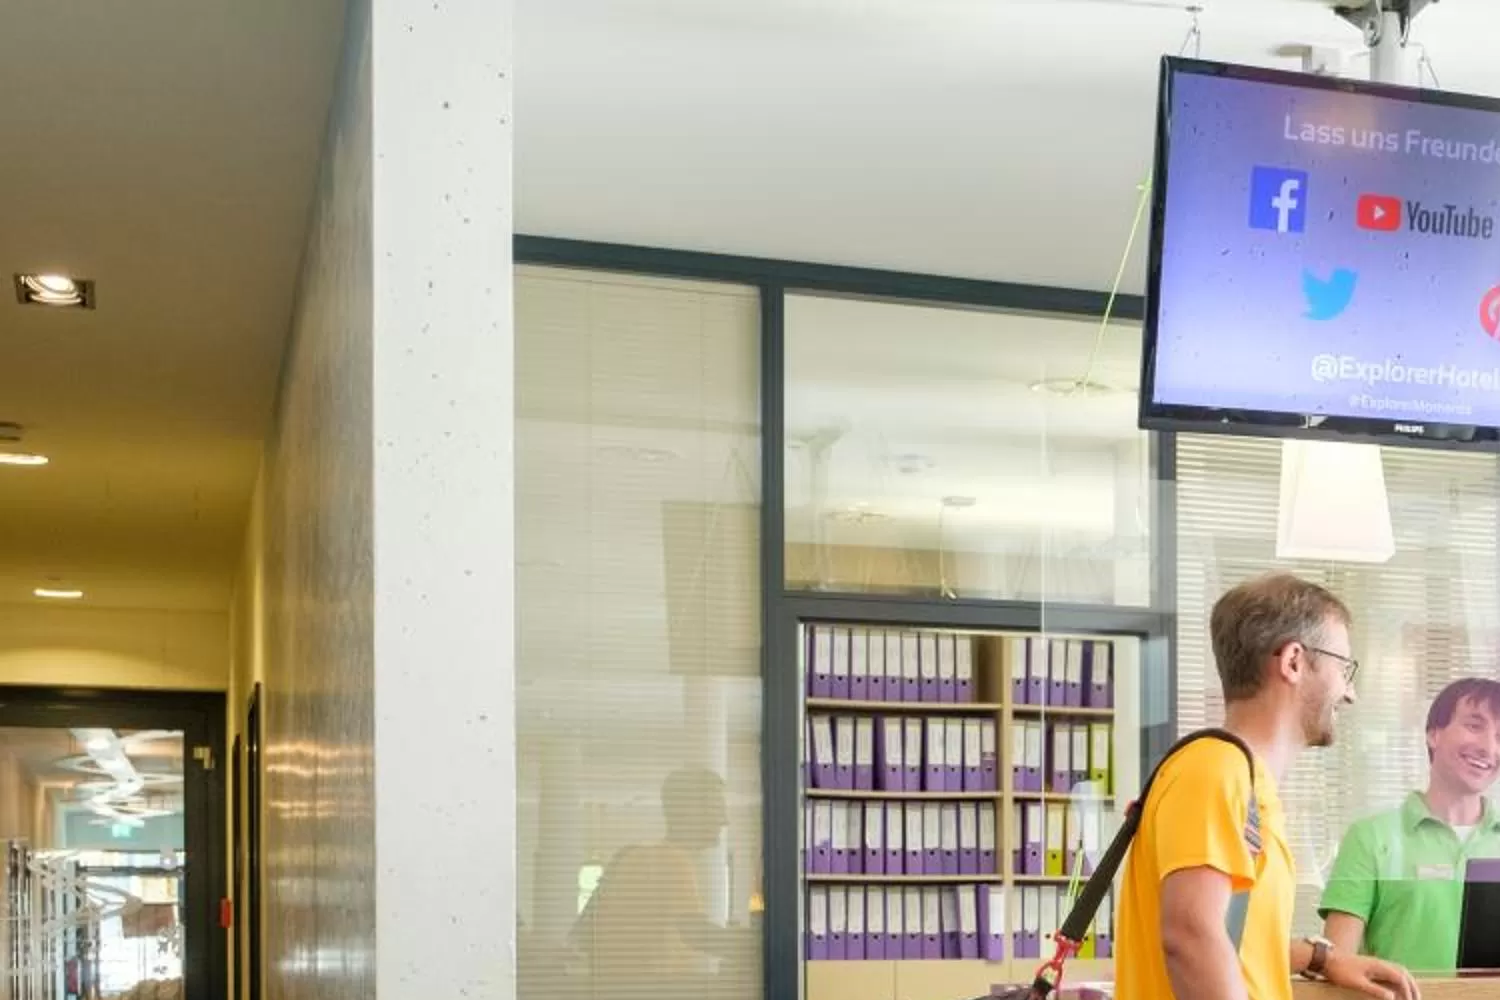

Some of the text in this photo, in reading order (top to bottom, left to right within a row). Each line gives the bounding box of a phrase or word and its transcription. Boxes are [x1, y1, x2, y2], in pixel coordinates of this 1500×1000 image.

[1284, 113, 1345, 146] Lass
[1351, 128, 1399, 152] uns
[1407, 200, 1494, 240] YouTube
